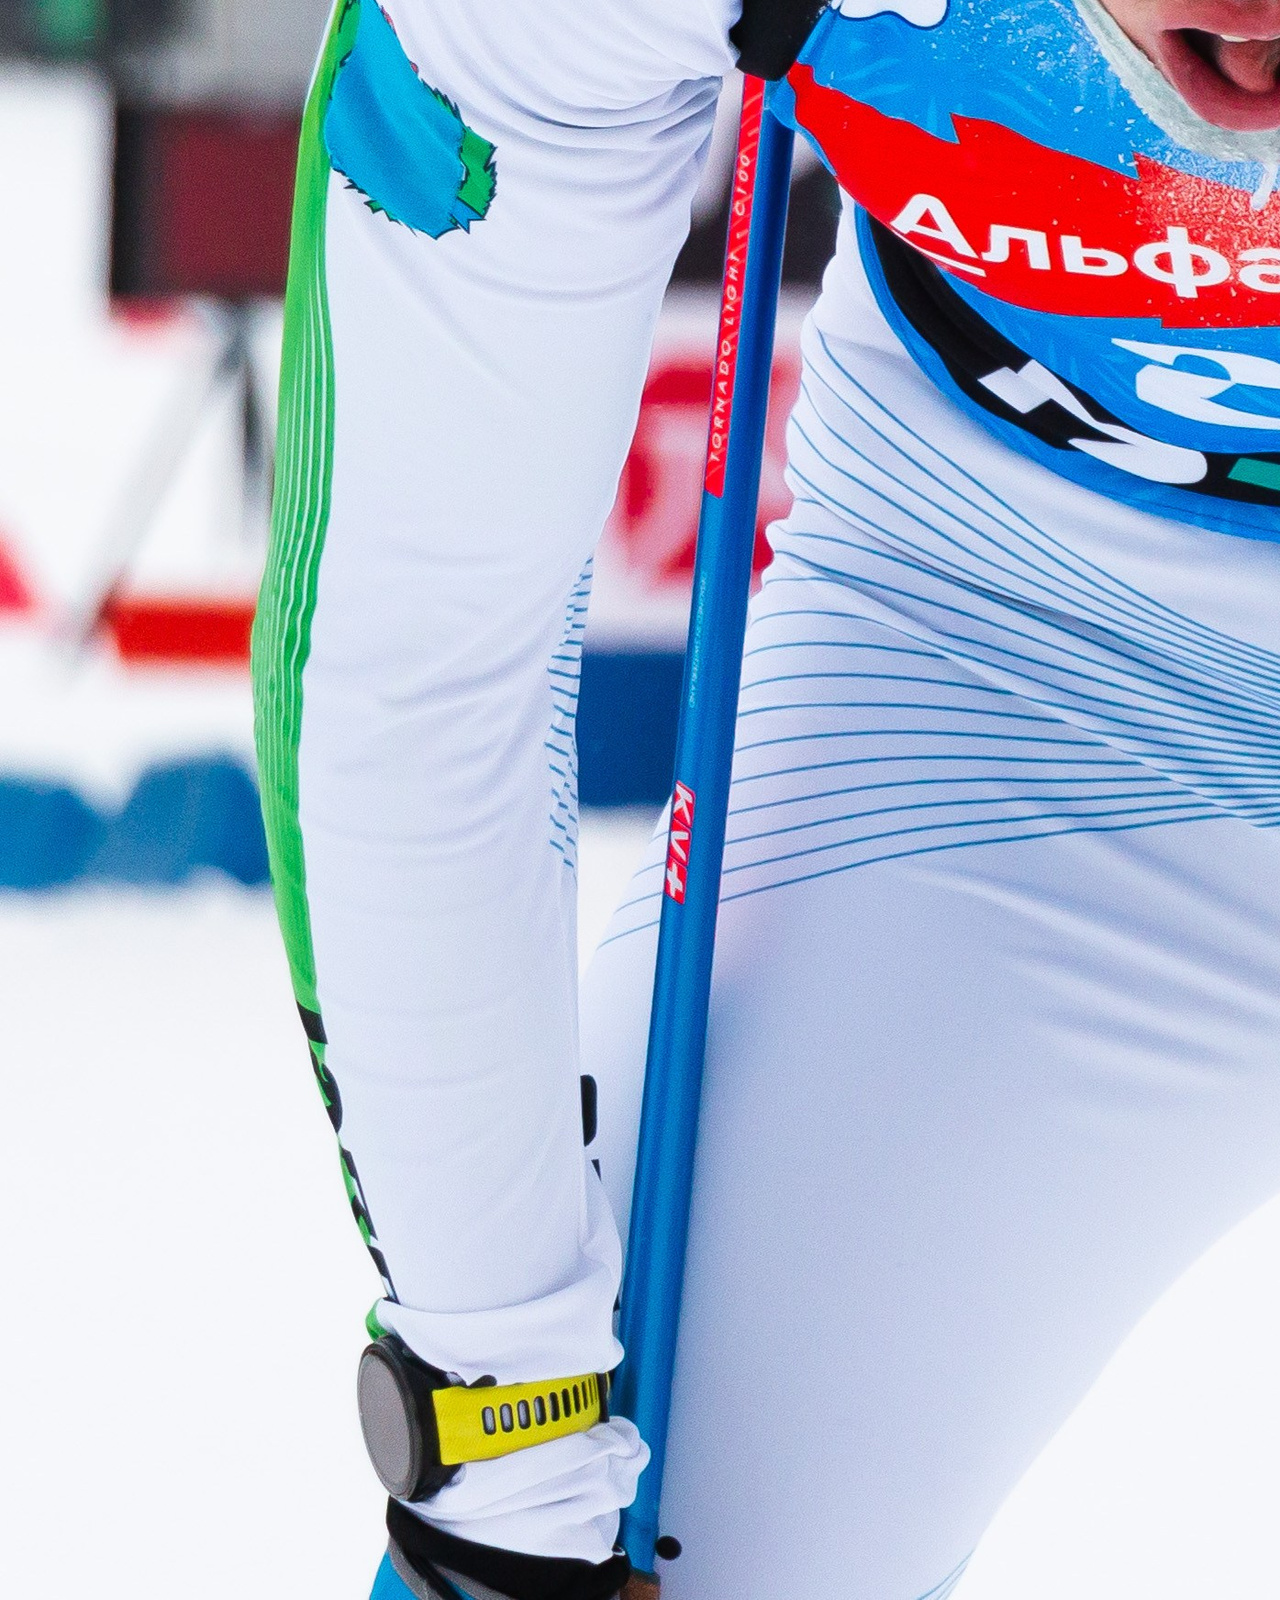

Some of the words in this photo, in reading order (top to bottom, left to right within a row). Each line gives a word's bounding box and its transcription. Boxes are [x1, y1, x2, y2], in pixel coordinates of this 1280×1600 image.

[710, 339, 732, 462] TORNADO
[724, 253, 741, 327] LIGHT
[735, 153, 752, 217] C100
